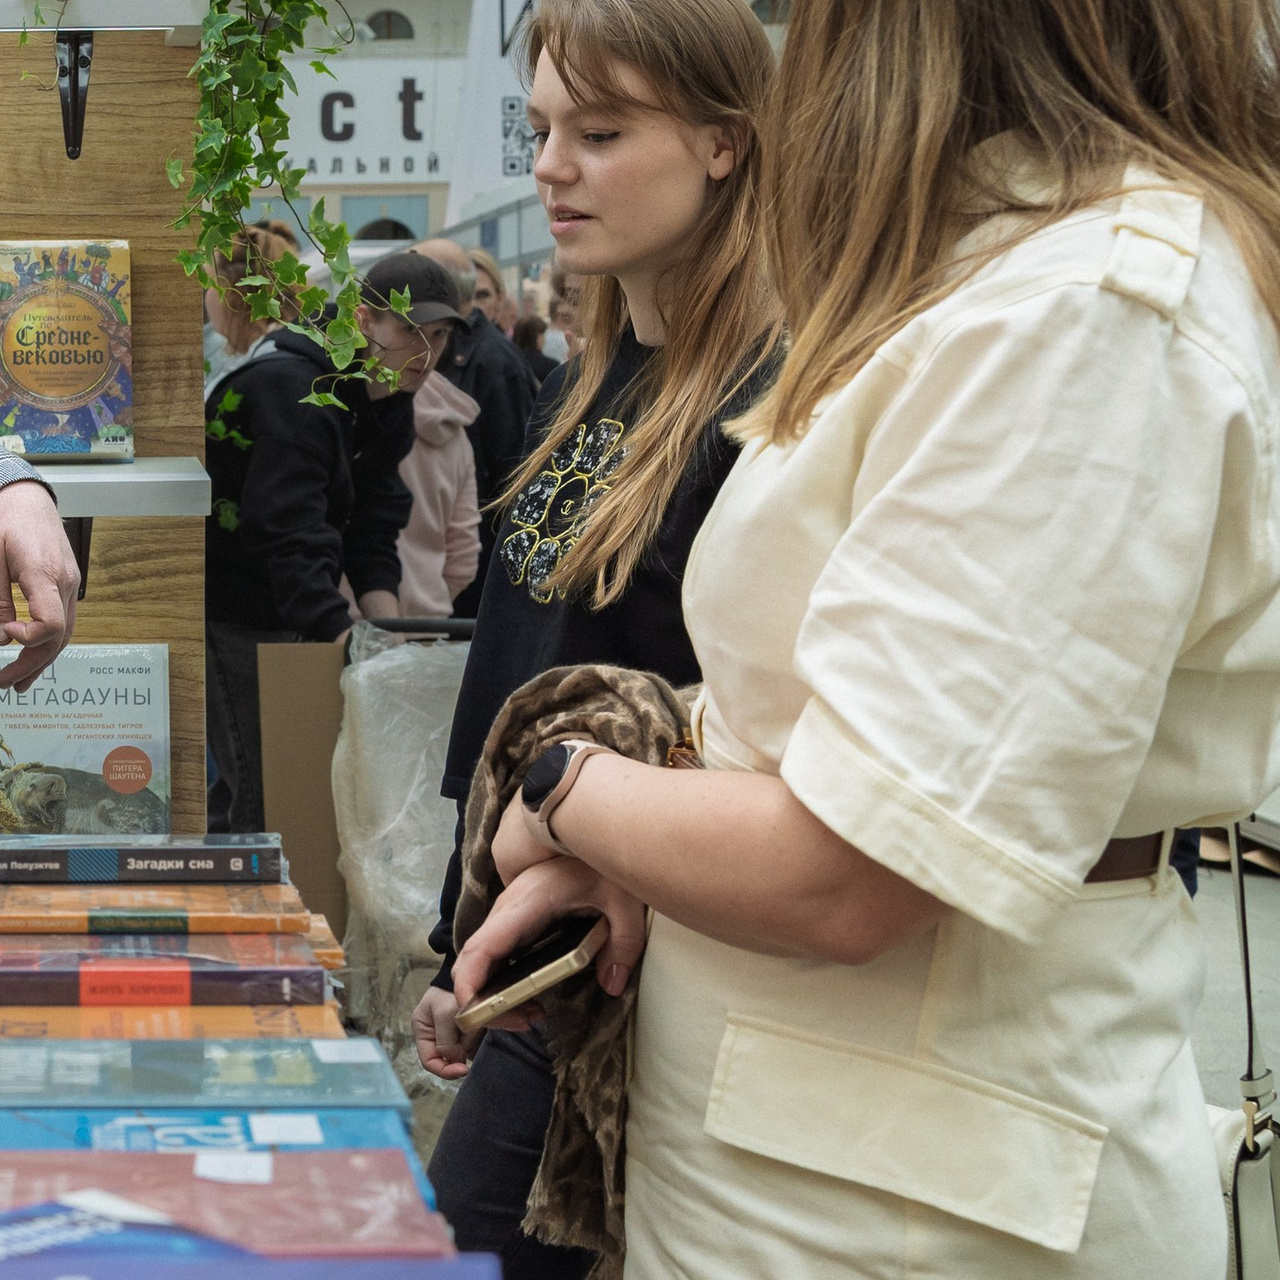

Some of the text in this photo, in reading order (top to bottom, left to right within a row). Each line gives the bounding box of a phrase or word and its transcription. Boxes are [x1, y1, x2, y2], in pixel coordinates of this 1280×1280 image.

[23, 313, 93, 324] Путеводитель
[16, 325, 100, 349] Средне-
[12, 347, 104, 365] вековью
[90, 667, 114, 675] РОСС
[117, 666, 151, 675] МАКФИ
[10, 861, 61, 870] Полуэктов
[126, 857, 184, 871] Загадки
[188, 859, 214, 870] сна
